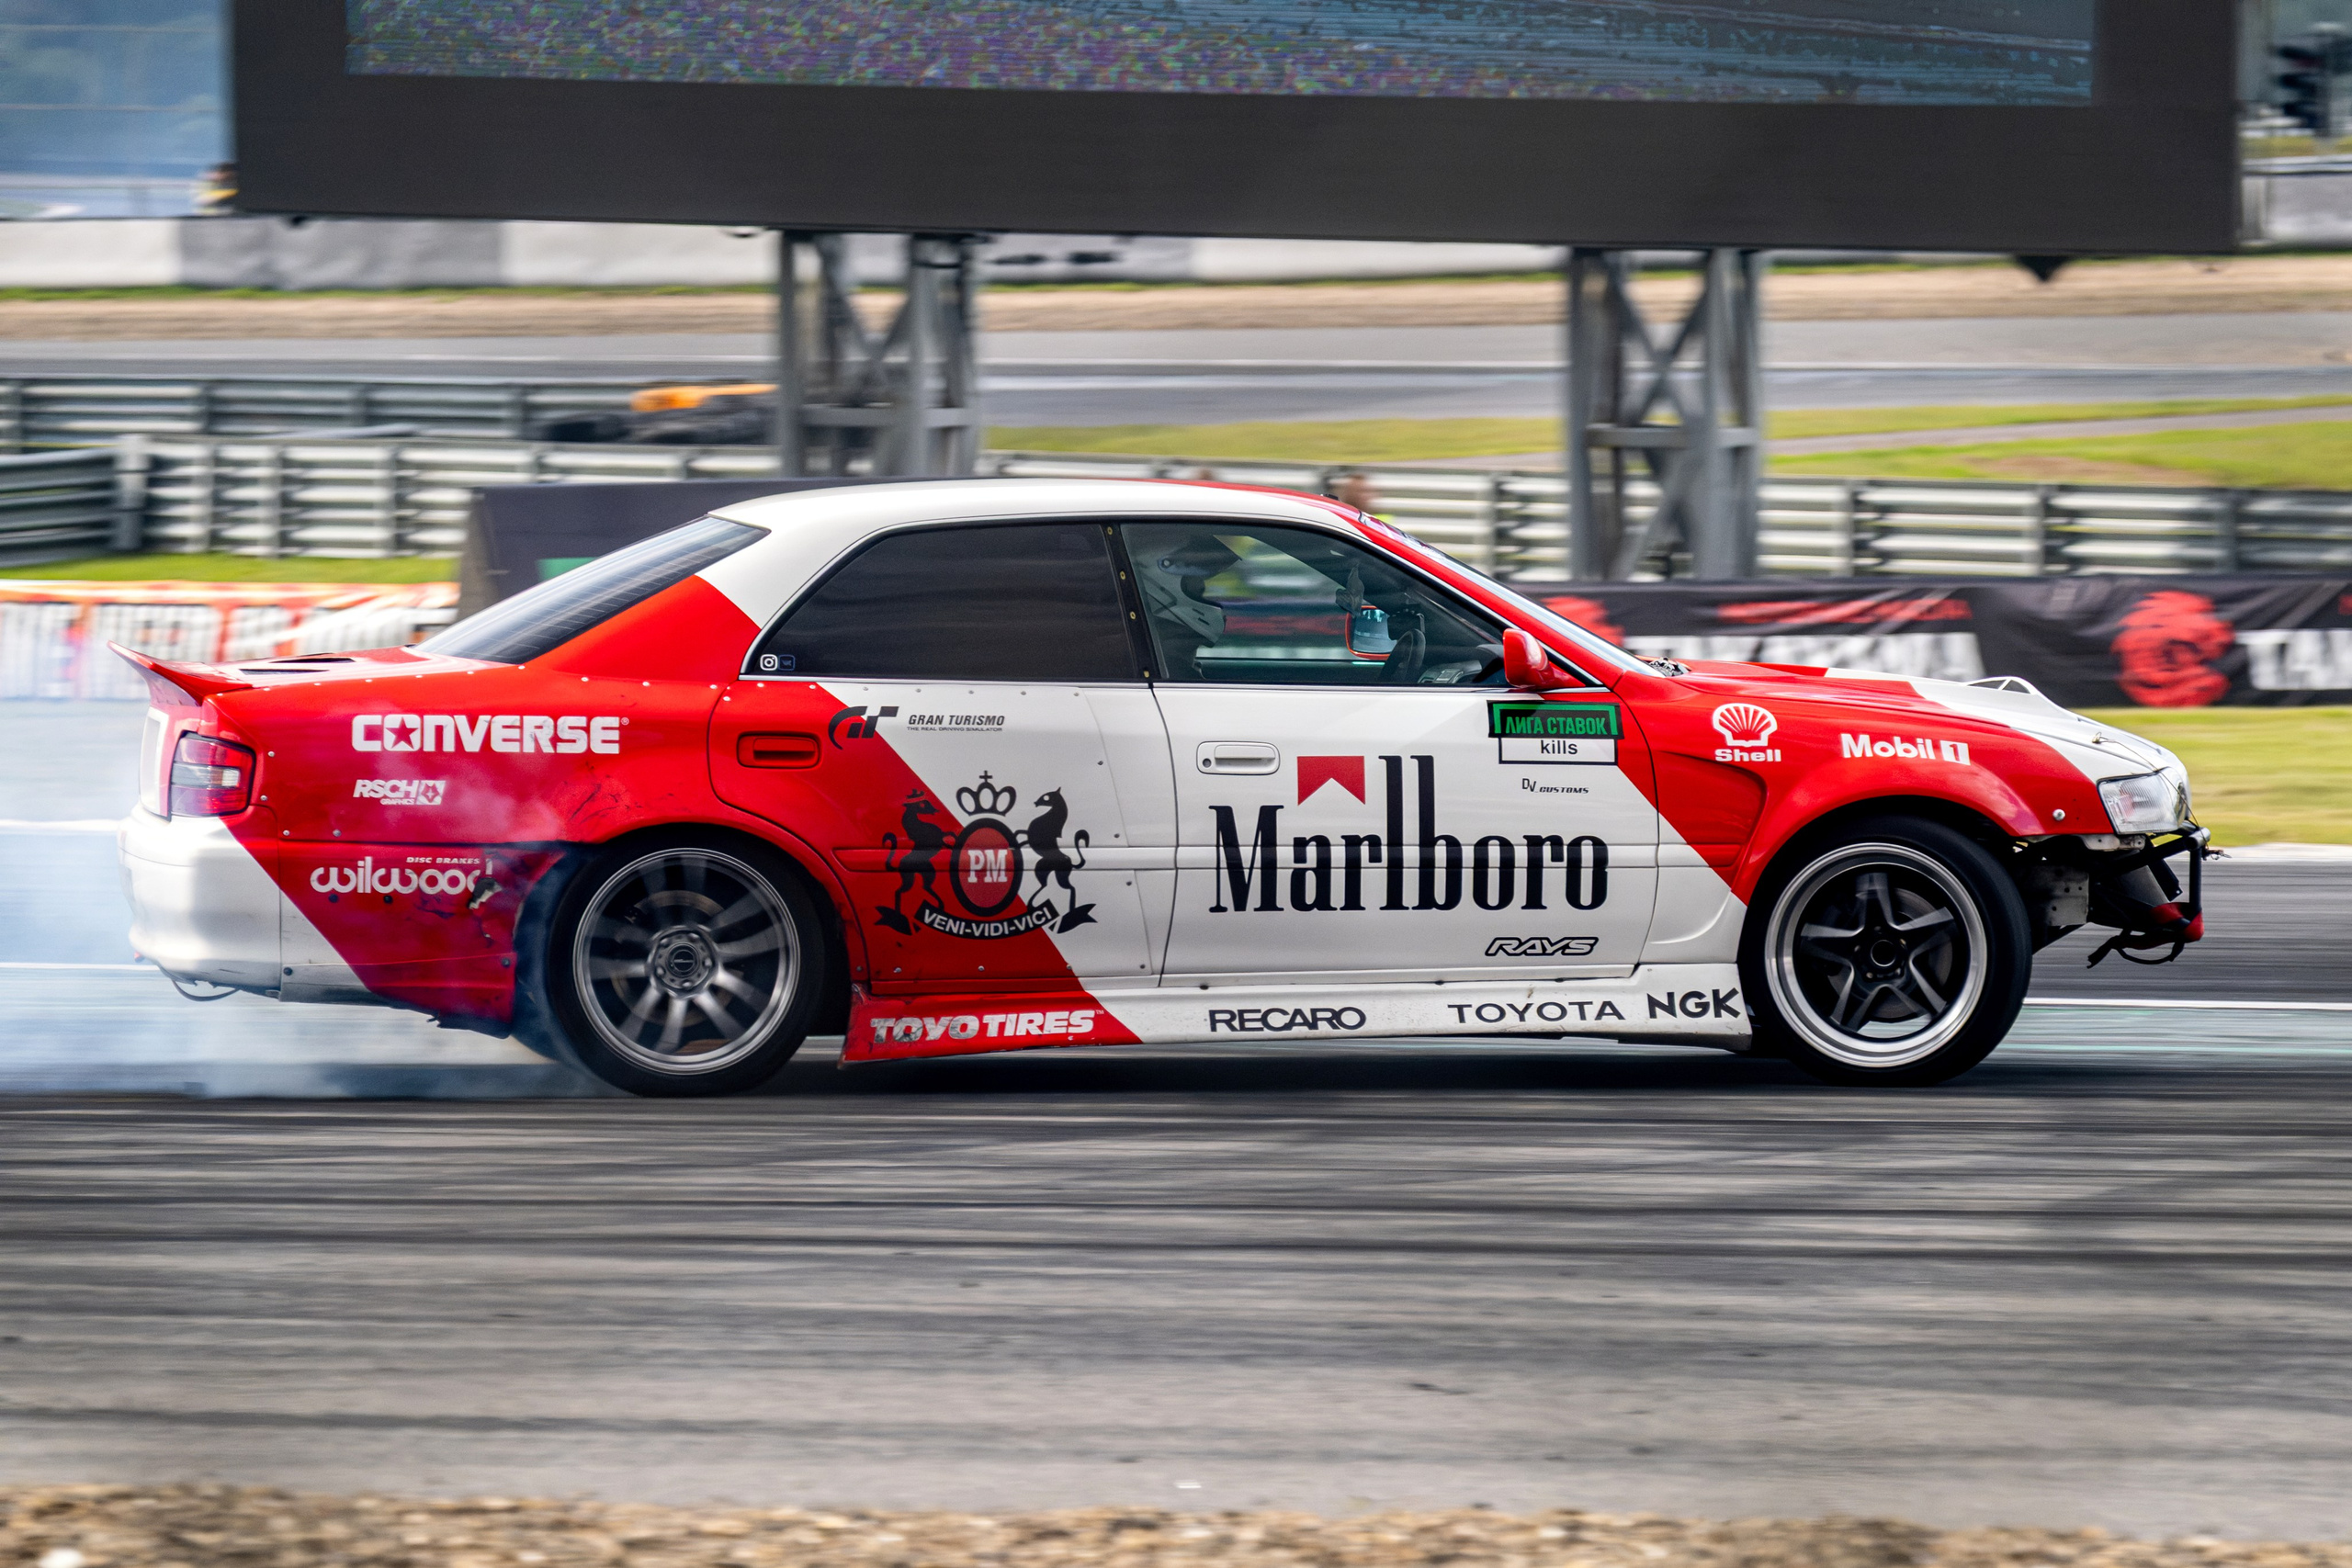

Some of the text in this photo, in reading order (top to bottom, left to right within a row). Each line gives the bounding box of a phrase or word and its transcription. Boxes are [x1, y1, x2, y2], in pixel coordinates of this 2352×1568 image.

[908, 715, 1005, 727] GRAN TURISMO
[1505, 716, 1608, 736] ЛИГА СТАВОК
[352, 714, 620, 754] CONVERSE
[1540, 739, 1578, 754] kills
[1840, 733, 1936, 760] Mobil
[1714, 749, 1781, 762] Shell
[353, 779, 420, 798] RSCH
[1208, 755, 1609, 913] Marlboro
[967, 849, 1008, 883] PM
[922, 907, 1052, 937] VENI-VIDI-VICI
[1485, 937, 1599, 956] RAYS
[1447, 1000, 1626, 1023] TOYOTA
[1646, 987, 1741, 1020] NGK
[870, 1010, 1095, 1044] TOYO TIRES
[1209, 1007, 1367, 1032] RECARO
